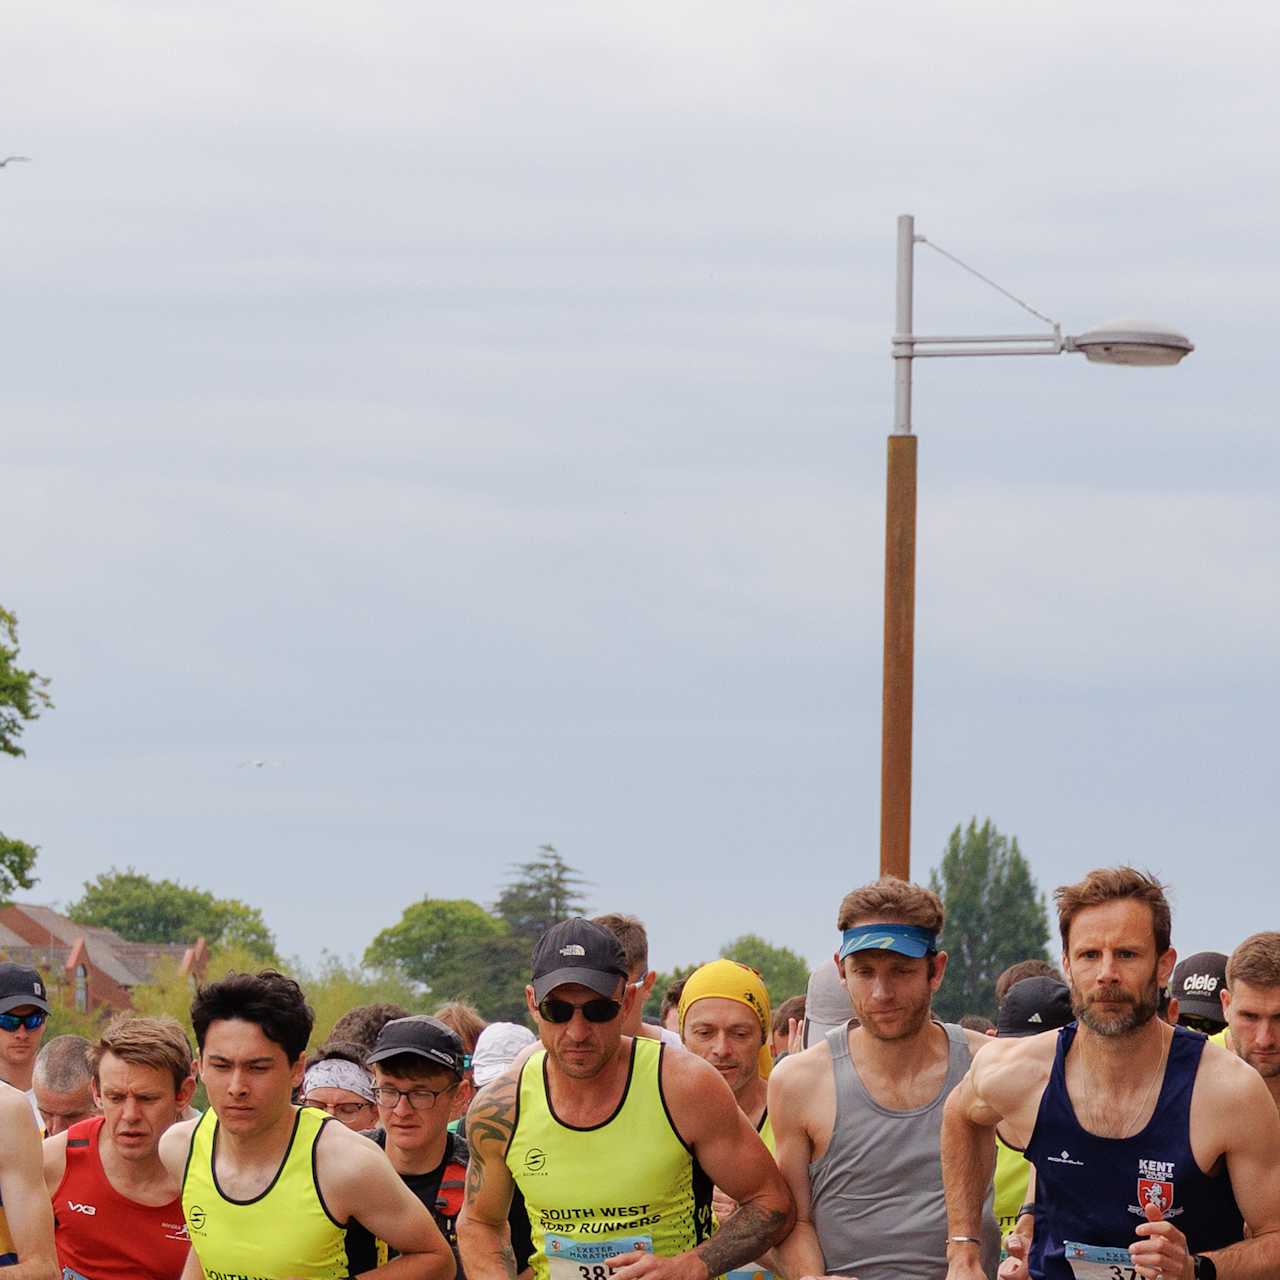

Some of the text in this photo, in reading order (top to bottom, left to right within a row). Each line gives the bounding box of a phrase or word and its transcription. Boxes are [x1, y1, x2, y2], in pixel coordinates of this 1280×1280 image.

[1139, 1159, 1175, 1173] KENT
[541, 1204, 650, 1220] SOUTH WEST
[579, 1214, 662, 1234] RUNNERS
